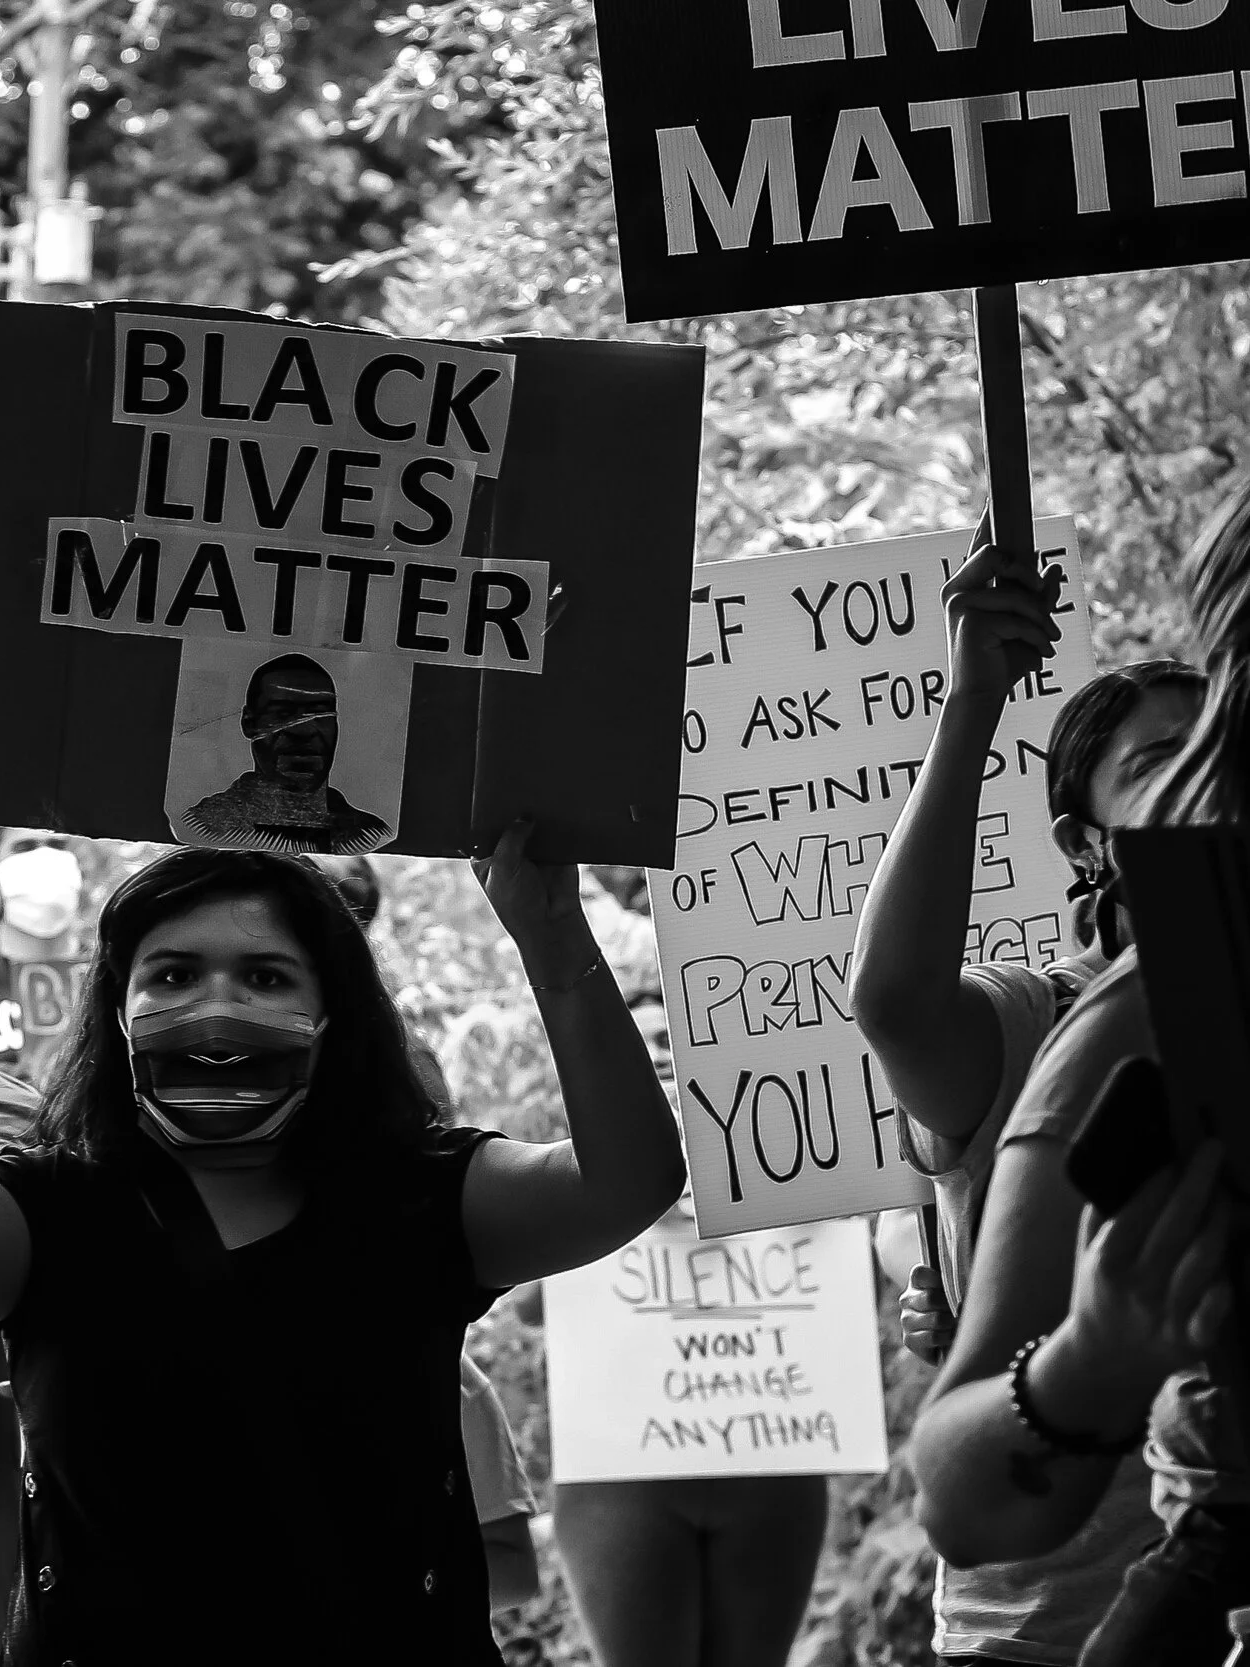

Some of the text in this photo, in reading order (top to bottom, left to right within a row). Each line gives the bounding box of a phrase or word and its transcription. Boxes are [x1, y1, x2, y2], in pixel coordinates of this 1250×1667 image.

[655, 70, 1250, 256] MATTE
[121, 327, 502, 454] BLACK
[143, 430, 456, 548] LIVES
[49, 528, 533, 662] MATTER
[790, 571, 917, 653] YOU
[739, 687, 842, 750] ASK
[860, 669, 951, 727] FOR
[672, 812, 1016, 926] OF WHE
[686, 1063, 841, 1204] YOU
[611, 1237, 820, 1309] SILENCE
[662, 1361, 814, 1403] CHANGE
[674, 1325, 788, 1362] WON'T
